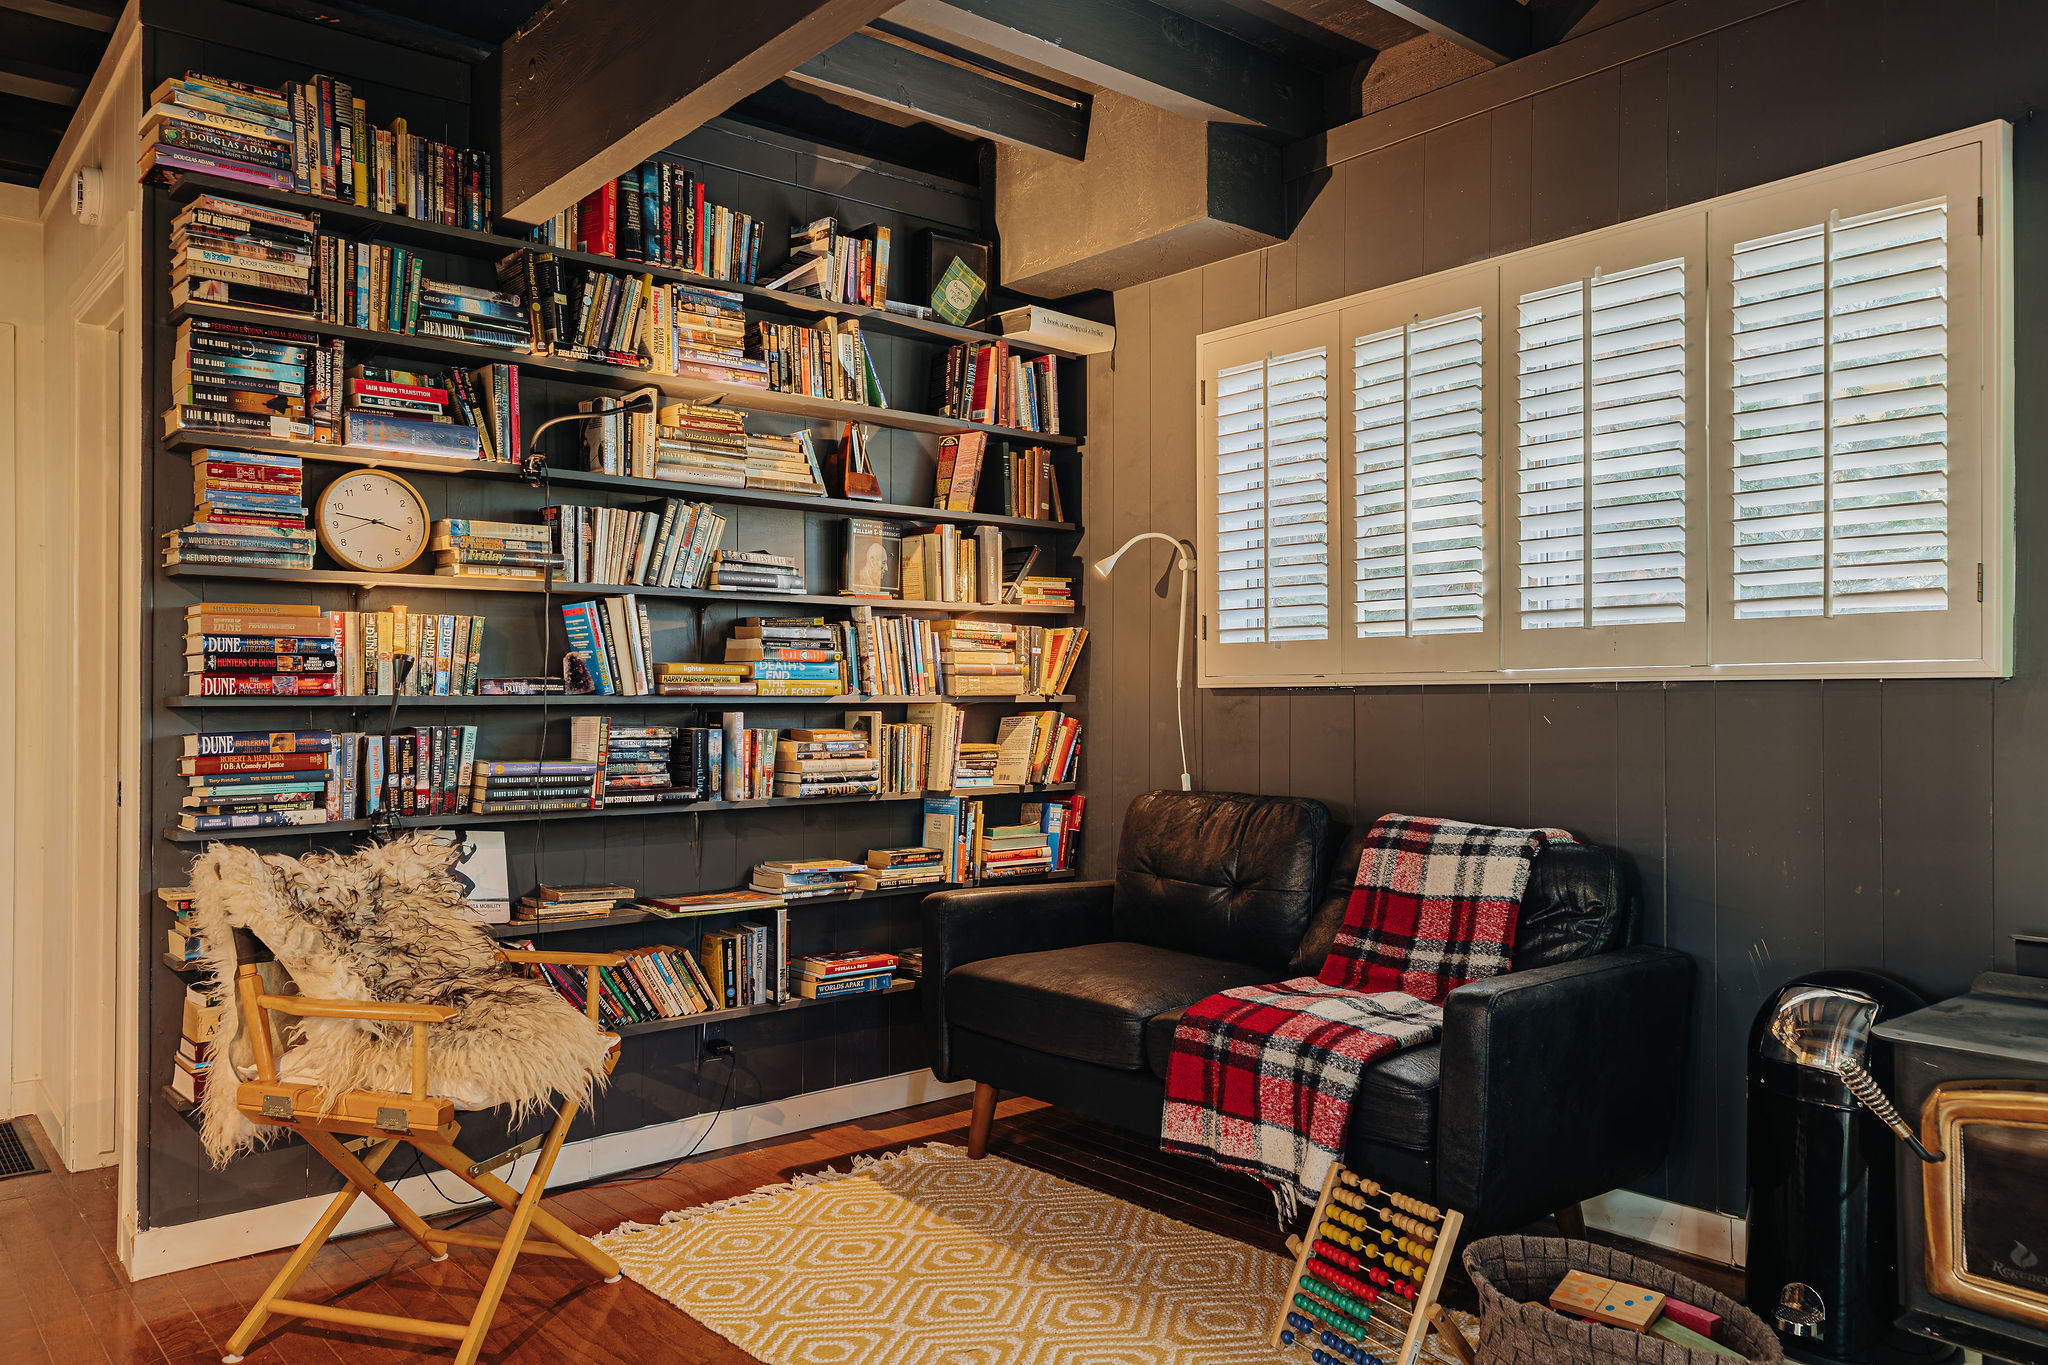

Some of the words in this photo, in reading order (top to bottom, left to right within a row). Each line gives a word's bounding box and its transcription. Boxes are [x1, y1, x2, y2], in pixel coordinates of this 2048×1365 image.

[294, 93, 305, 123] ASIMOV
[335, 81, 352, 126] ASIMOV
[306, 102, 314, 134] ASIMOV
[190, 132, 239, 150] DOUGLAS
[243, 144, 278, 158] ADAMS
[173, 154, 197, 163] DOUGLAS
[198, 158, 215, 166] ADAMS
[225, 151, 242, 159] GUIDE
[261, 158, 278, 166] GALAXY
[198, 212, 212, 225] RAY
[212, 216, 250, 232] BRADBURY
[260, 239, 273, 247] 451
[203, 251, 211, 260] Ray
[211, 252, 231, 263] Bradbury
[200, 265, 239, 279] TWICE
[424, 295, 438, 303] GREG
[439, 298, 455, 306] BEAR
[1047, 317, 1059, 327] book
[211, 322, 239, 332] FEERSUM
[240, 326, 264, 334] ENDJINN
[268, 329, 279, 338] IAIN
[287, 333, 307, 341] BANKS
[424, 320, 441, 335] BEN
[443, 322, 465, 340] BOVA
[215, 341, 229, 349] BANKS
[211, 360, 225, 368] BANKS
[366, 384, 378, 392] IAIN
[379, 385, 398, 394] BANKS
[399, 388, 431, 398] TRANSITION
[213, 395, 228, 403] BANKS
[332, 382, 341, 421] TOMORROW
[186, 410, 201, 420] IAIN
[204, 413, 213, 421] M.
[214, 413, 235, 423] BANKS
[495, 409, 503, 453] TOMORROW
[345, 489, 353, 497] 11
[188, 537, 213, 545] WINTER
[221, 538, 237, 546] EDEN
[238, 539, 259, 547] HARRY
[260, 540, 291, 548] HARRISON
[186, 554, 209, 562] RETURN
[210, 554, 217, 562] TO
[218, 554, 232, 562] EDEN
[377, 554, 383, 562] 6
[395, 548, 400, 556] 5
[468, 549, 505, 564] Friday
[214, 623, 242, 632] DUNE
[208, 637, 241, 652] DUNE
[335, 628, 343, 656] DUNE
[366, 627, 374, 657] DUNE
[427, 629, 436, 657] DUNE
[444, 627, 452, 657] DUNE
[218, 658, 247, 667] HUNTERS
[249, 659, 258, 667] OF
[259, 659, 276, 667] DUNE
[683, 665, 704, 673] lighter
[759, 662, 806, 671] DEATH'S
[765, 671, 790, 679] END
[204, 678, 237, 695] DUNE
[762, 688, 788, 696] DARK
[791, 688, 826, 696] FOREST
[202, 736, 234, 754] DUNE
[465, 732, 473, 759] PRATCHETT
[241, 762, 261, 770] Comedy
[826, 785, 856, 795] VENTUS
[819, 983, 845, 992] WORLDS
[845, 980, 865, 989] APART
[1992, 1260, 2048, 1287] Regency
